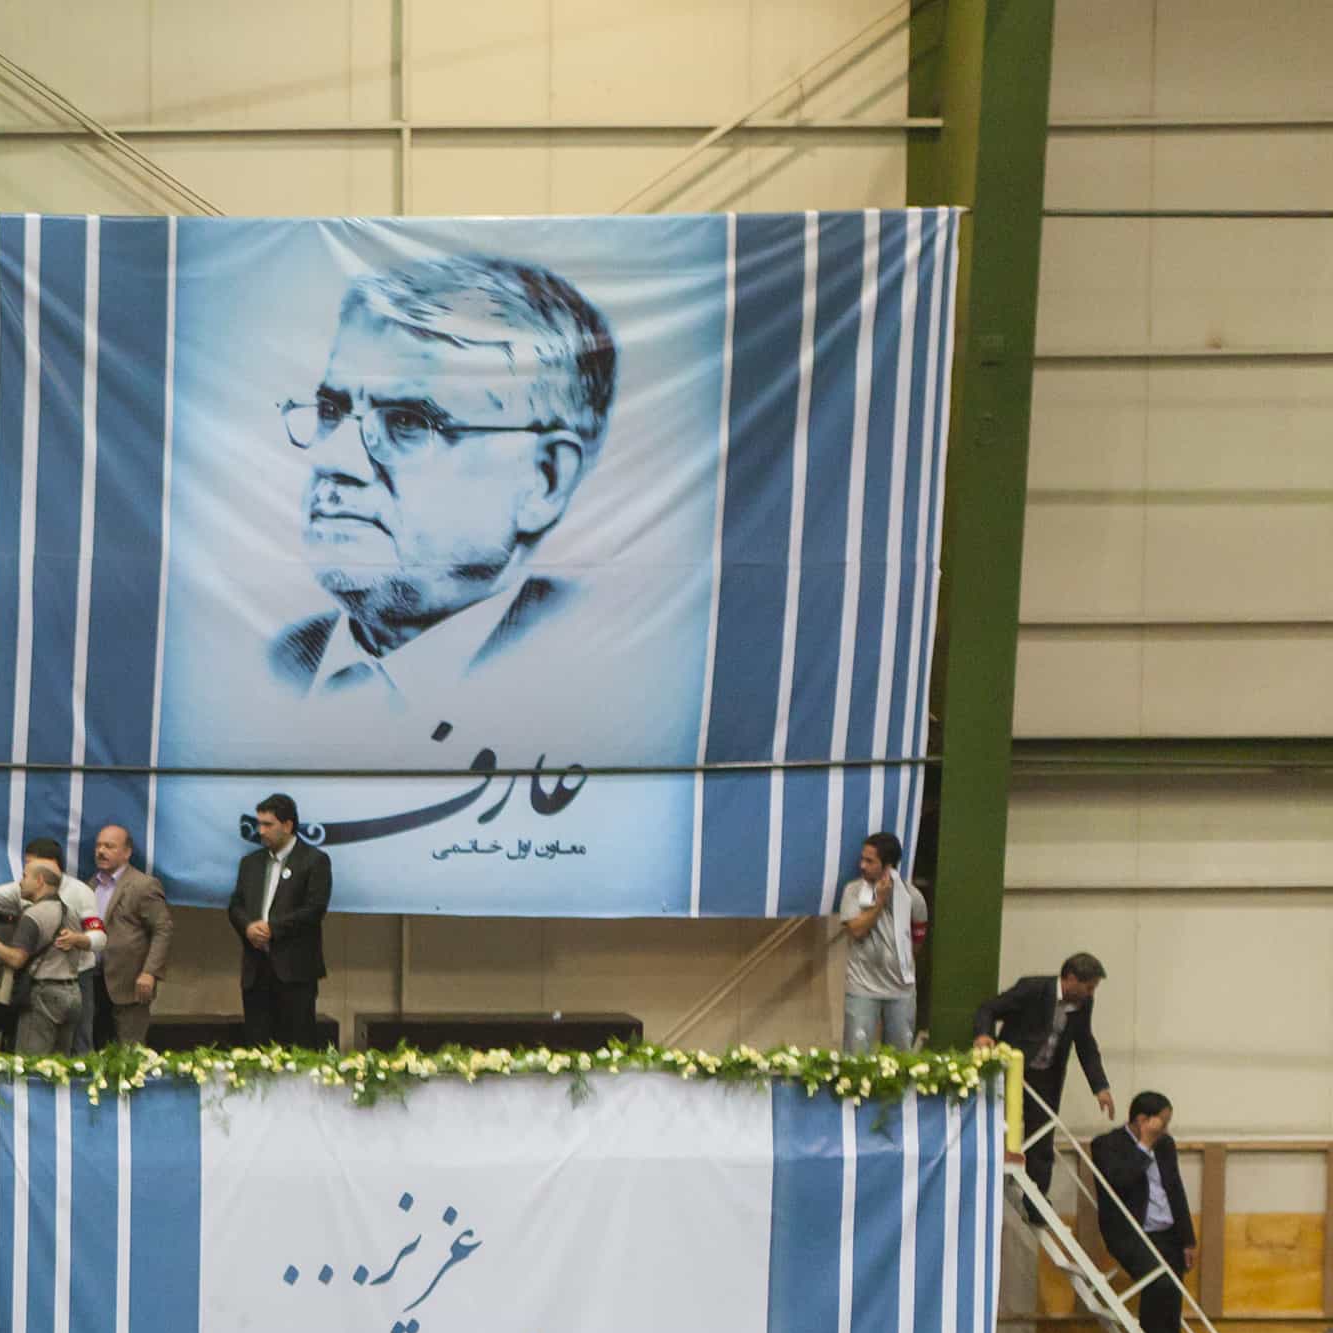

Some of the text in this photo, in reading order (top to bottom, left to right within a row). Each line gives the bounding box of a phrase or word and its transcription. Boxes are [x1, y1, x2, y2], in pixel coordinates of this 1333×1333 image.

[240, 720, 587, 845] عارف
[432, 838, 586, 860] معاون اول خاتمی
